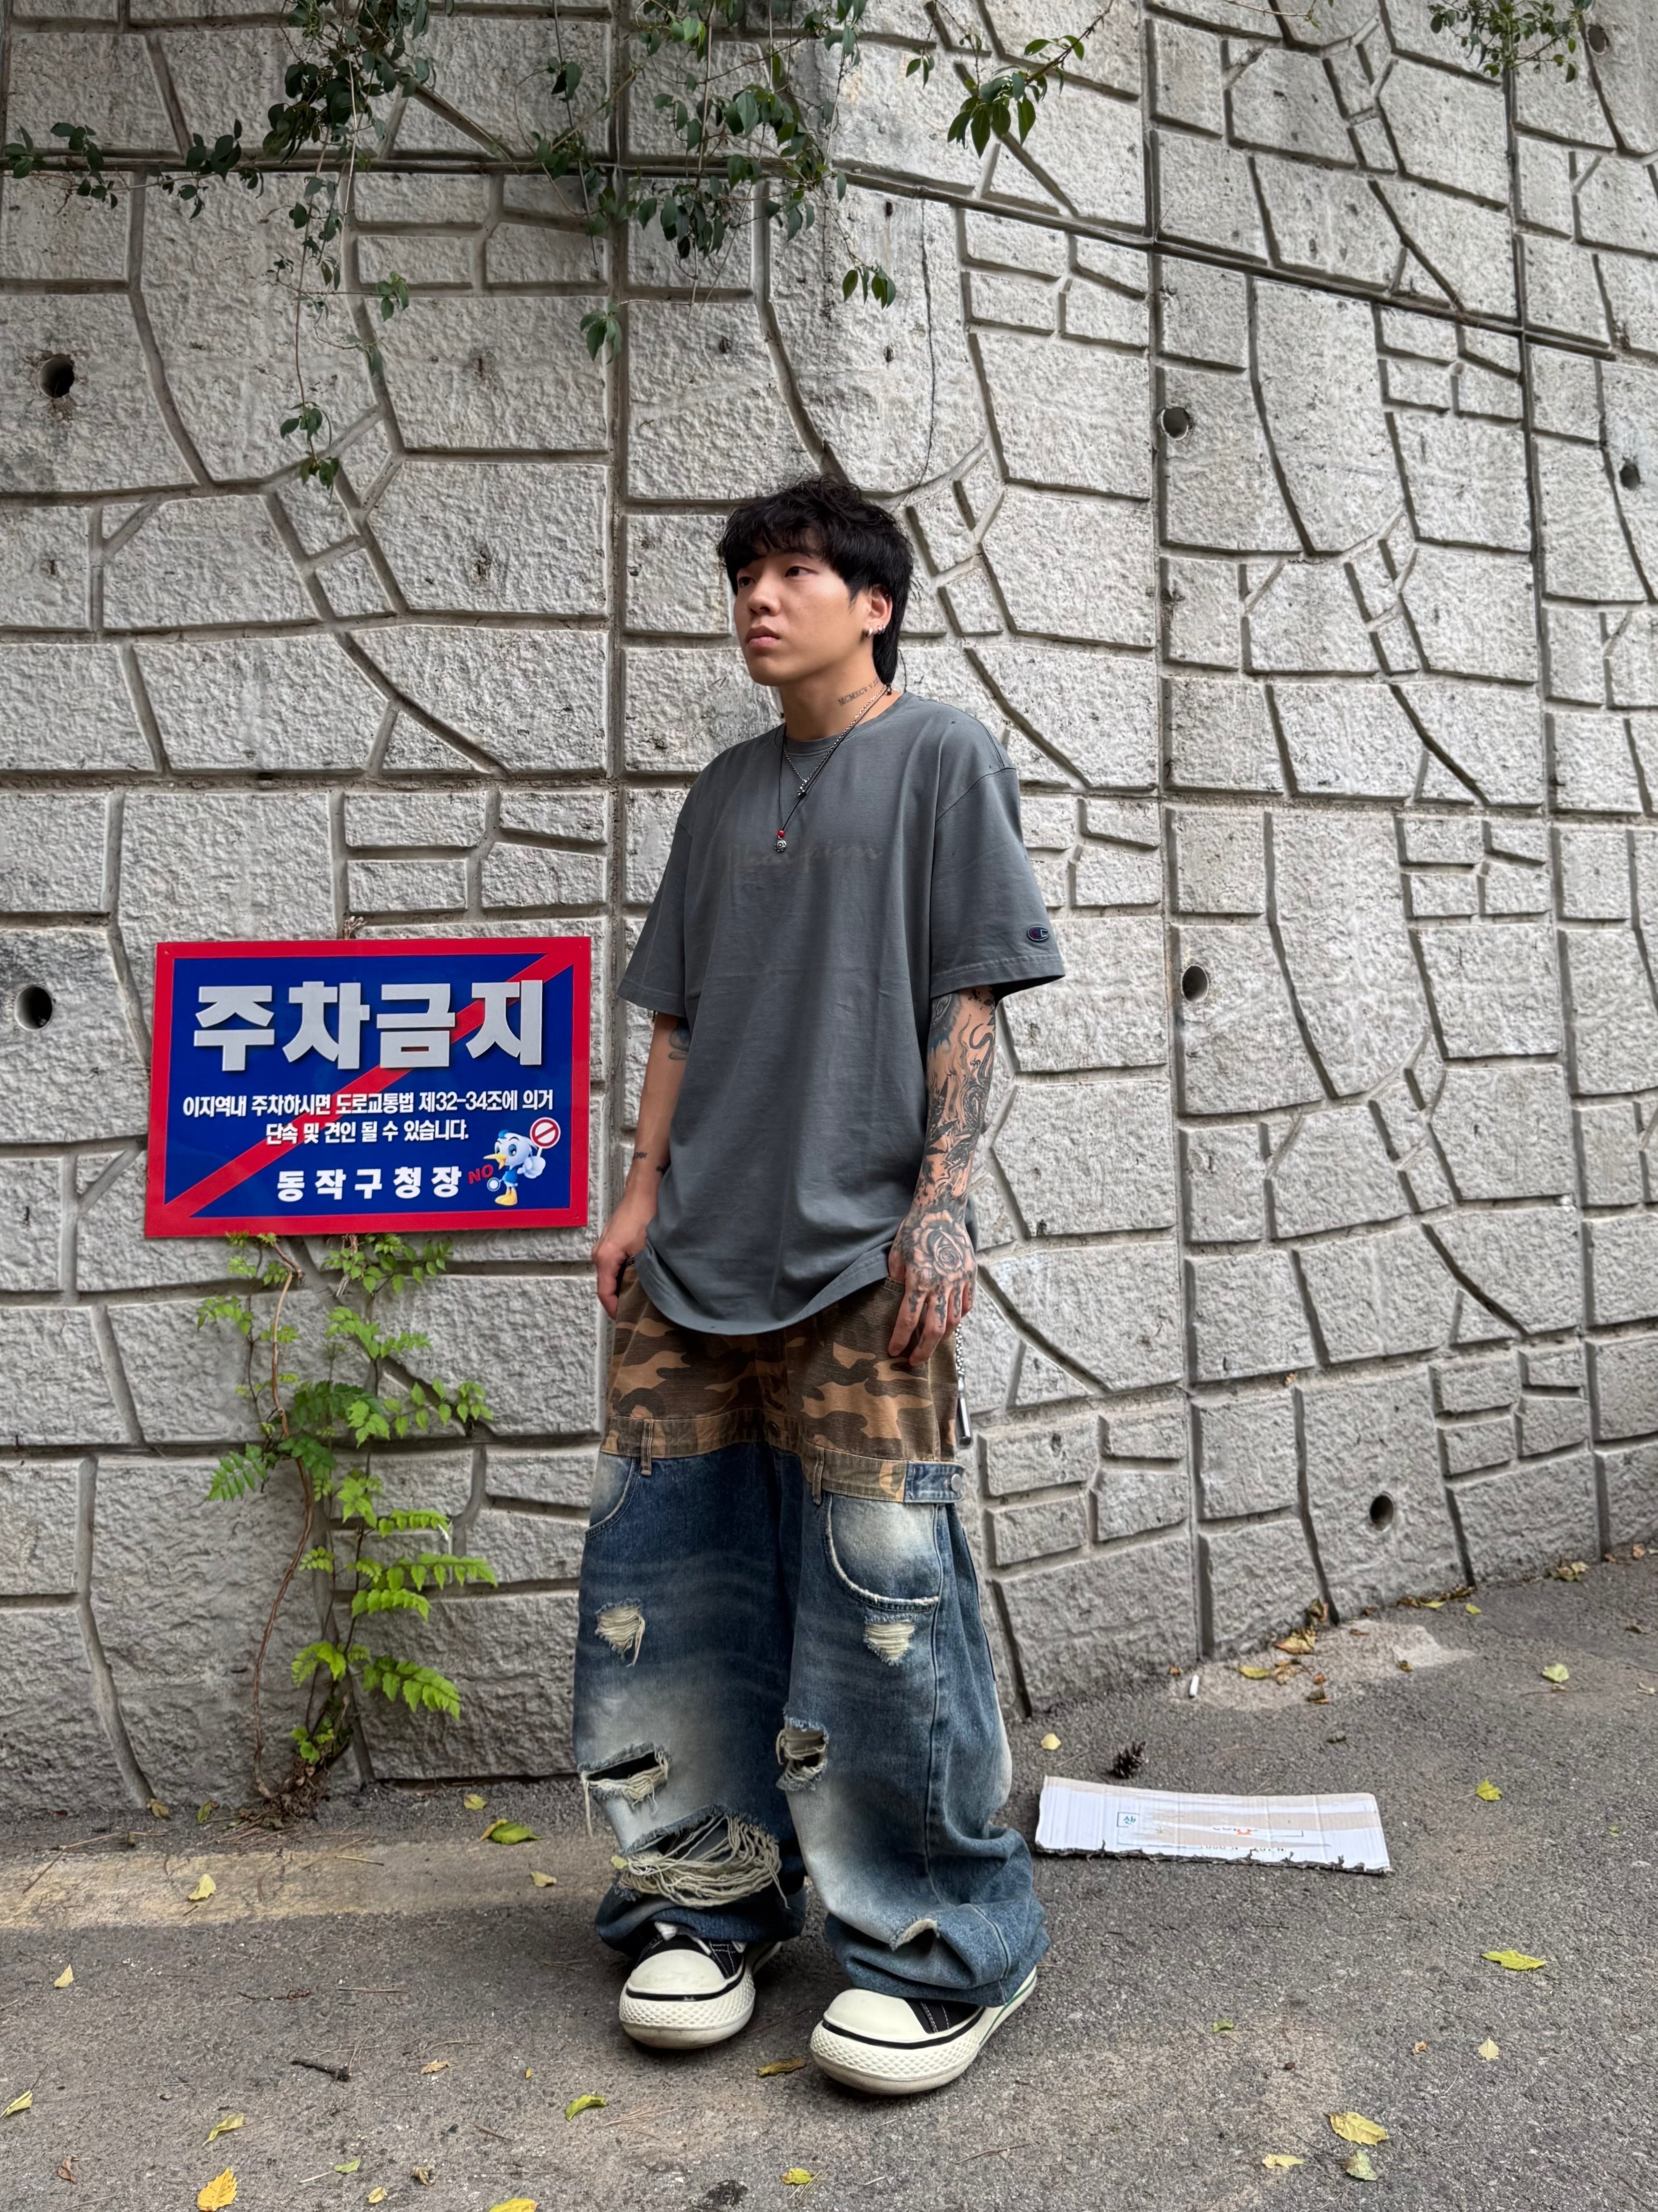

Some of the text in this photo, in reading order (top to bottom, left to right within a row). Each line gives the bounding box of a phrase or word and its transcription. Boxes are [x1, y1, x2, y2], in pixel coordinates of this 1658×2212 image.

[194, 980, 543, 1071] 주차금지
[183, 1089, 553, 1117] 이지역내 주차하시면 도로교통법 제32-34조에 의거
[266, 1120, 469, 1144] 단속 및 견인 될 수 있습니다.
[467, 1164, 493, 1184] NO
